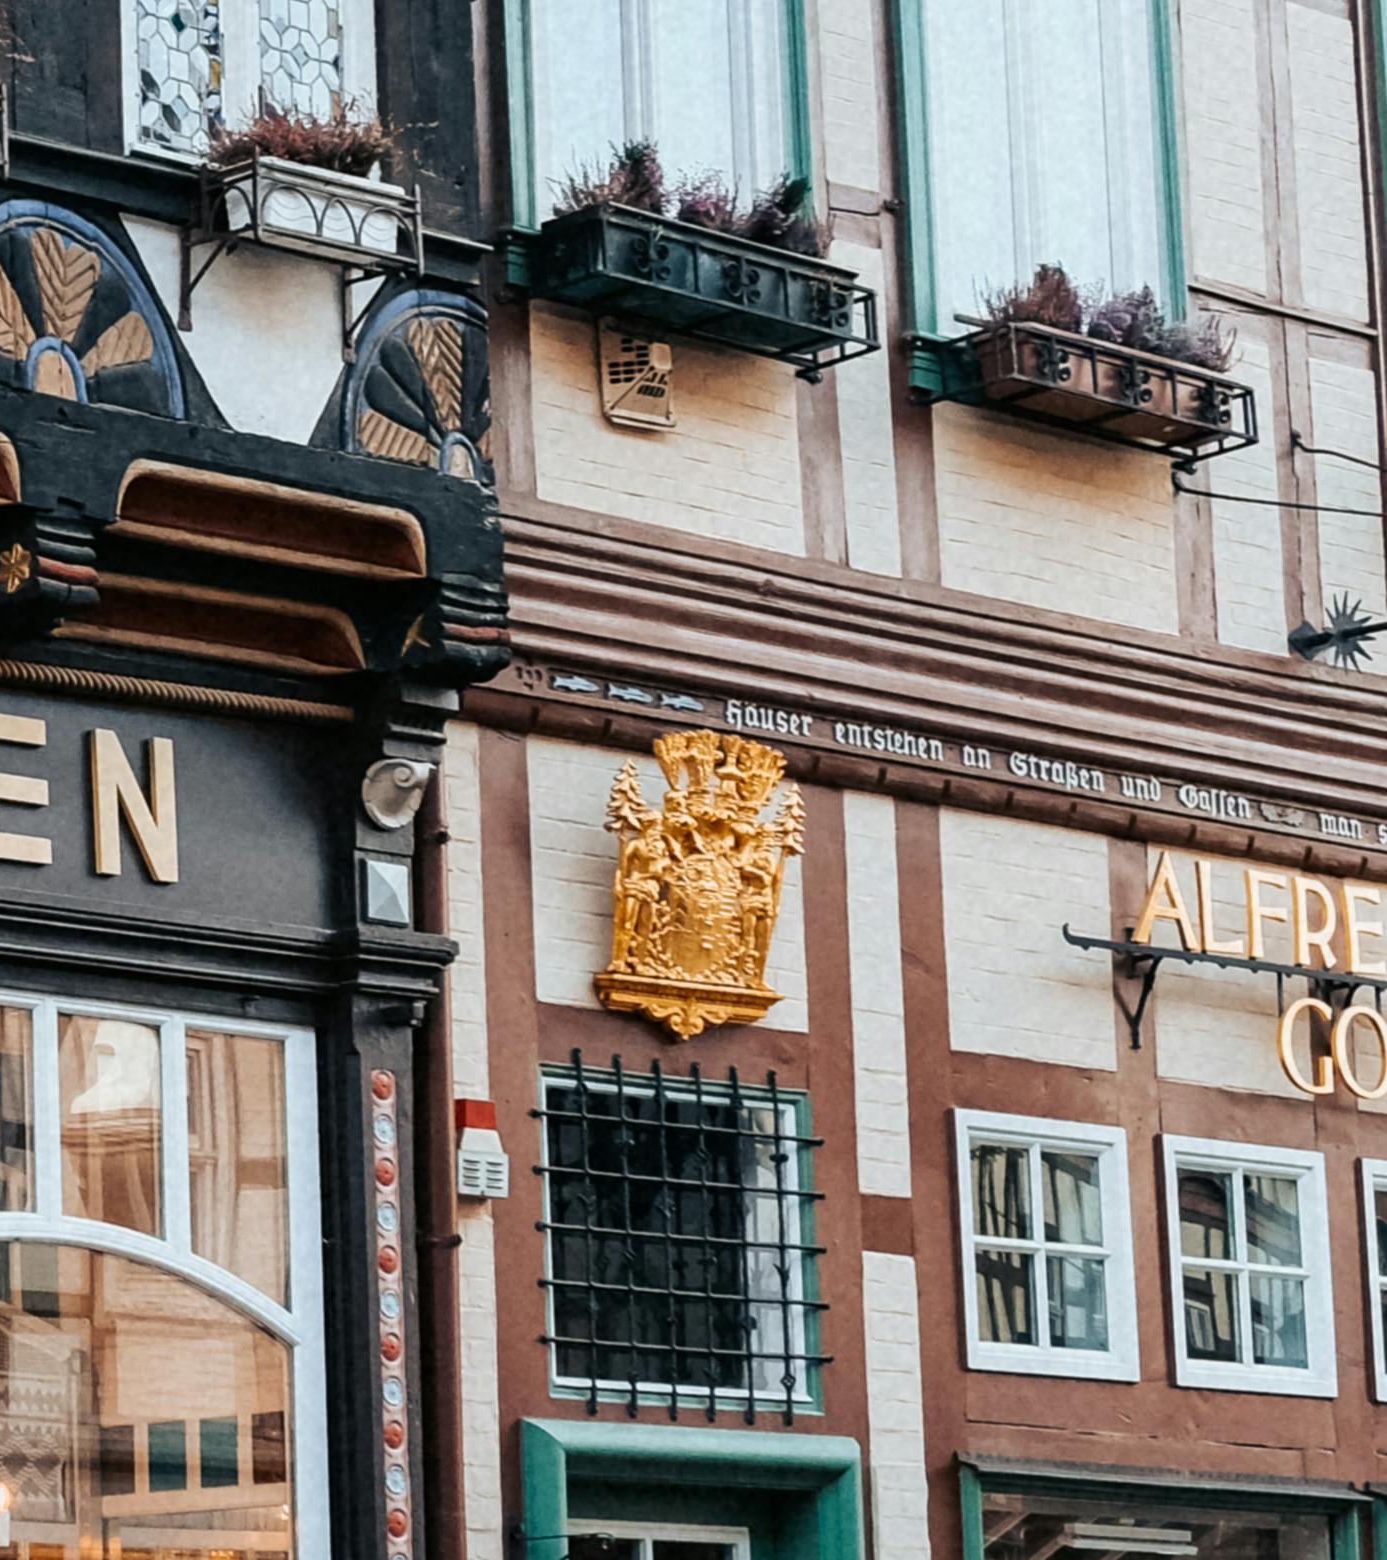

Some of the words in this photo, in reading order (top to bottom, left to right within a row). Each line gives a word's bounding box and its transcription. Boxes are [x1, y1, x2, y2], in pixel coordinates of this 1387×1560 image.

[726, 697, 814, 738] Häuser
[834, 720, 944, 762] entstehen
[962, 744, 991, 771] an
[1121, 774, 1161, 802] und
[1319, 813, 1363, 839] man
